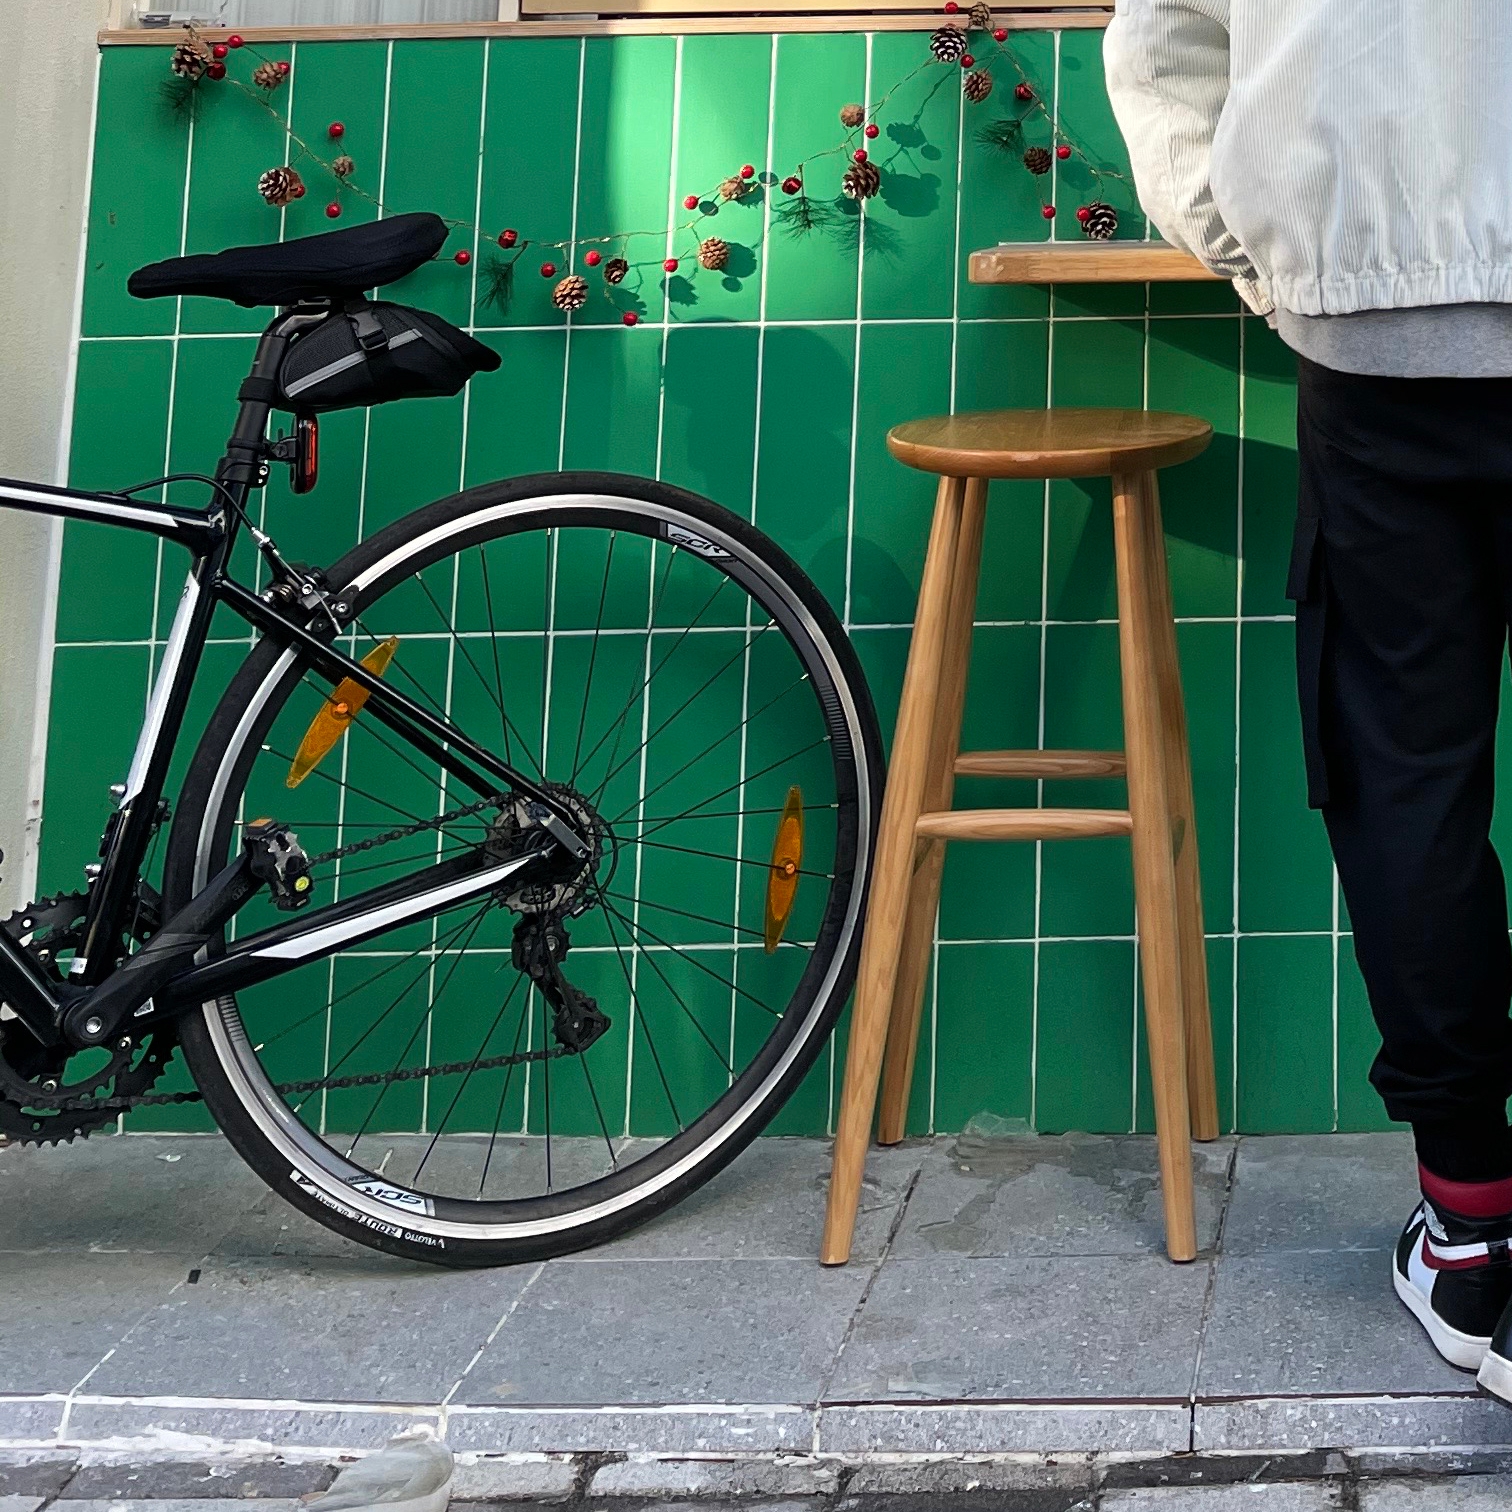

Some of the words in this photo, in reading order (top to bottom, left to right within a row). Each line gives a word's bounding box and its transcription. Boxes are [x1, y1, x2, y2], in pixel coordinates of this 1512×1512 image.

[670, 533, 721, 554] SCR
[364, 1185, 422, 1205] SCR
[354, 1213, 398, 1235] ROUTE
